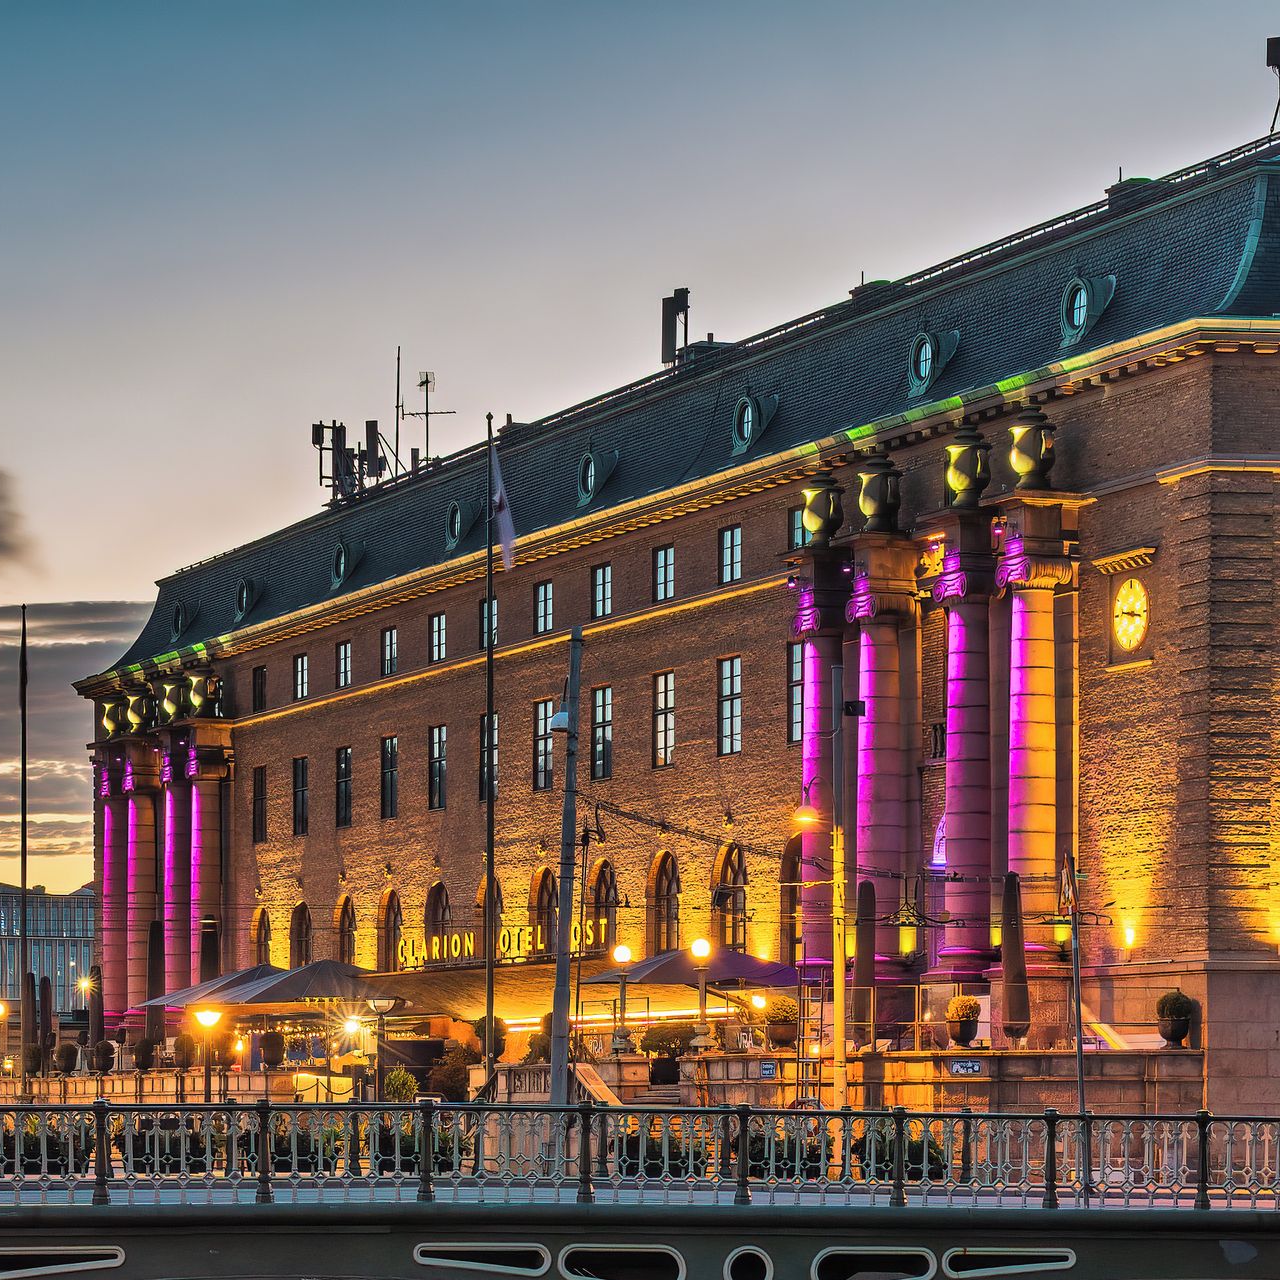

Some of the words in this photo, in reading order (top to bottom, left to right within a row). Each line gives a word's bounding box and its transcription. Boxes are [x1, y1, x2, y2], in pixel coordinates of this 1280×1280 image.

[397, 932, 475, 963] CLARION
[499, 924, 545, 953] OTEL
[571, 918, 608, 948] OST
